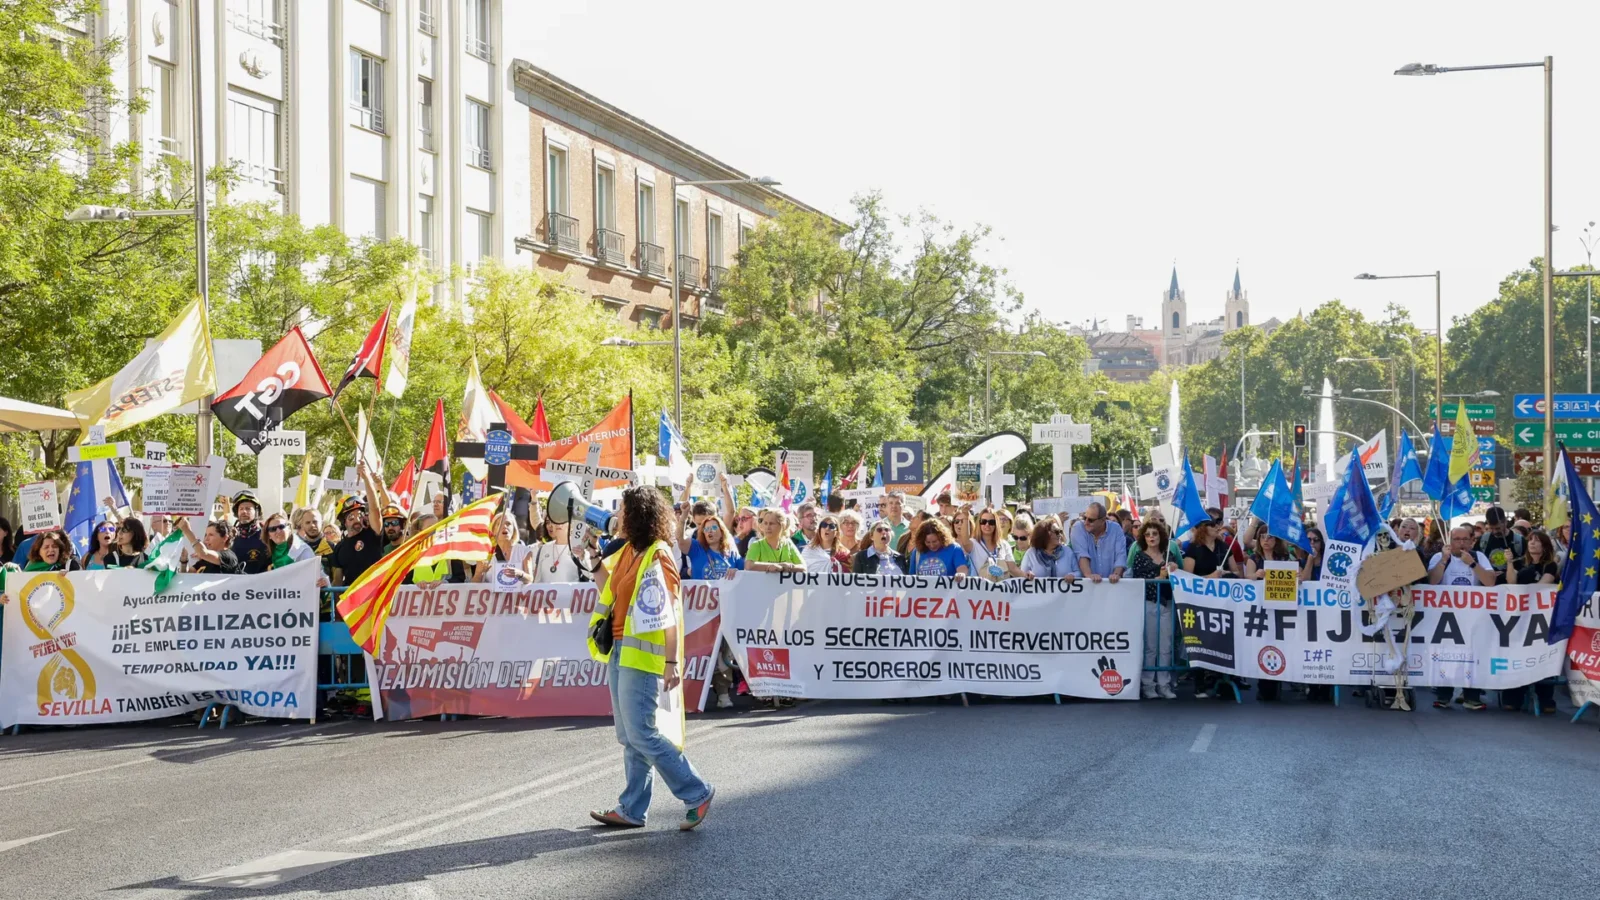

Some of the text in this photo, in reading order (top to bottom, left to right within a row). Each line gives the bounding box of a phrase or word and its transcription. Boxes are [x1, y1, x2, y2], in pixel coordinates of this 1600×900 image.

[1572, 431, 1583, 439] de
[146, 450, 166, 461] RIP
[890, 446, 915, 482] P
[1328, 541, 1358, 555] AÑOS
[123, 587, 301, 609] Ayuntamiento de Sevilla:
[388, 589, 460, 617] UIENES
[1505, 592, 1530, 612] DE
[968, 598, 1011, 622] YA!!
[1182, 608, 1231, 635] #15F
[112, 635, 312, 654] DEL EMPLEO EN ABUSO DE
[736, 626, 1130, 651] PARA LOS SECRETARIOS, INTERVENTORES
[122, 654, 297, 675] TEMPORALIDAD YA!!!
[496, 660, 534, 689] DEL
[539, 659, 609, 688] PERSO
[756, 662, 785, 672] ANSITI
[813, 660, 1042, 681] Y TESOREROS INTERINOS
[37, 698, 113, 717] SEVILLA
[116, 691, 190, 715] TAMBIÉN
[192, 690, 214, 702] ES
